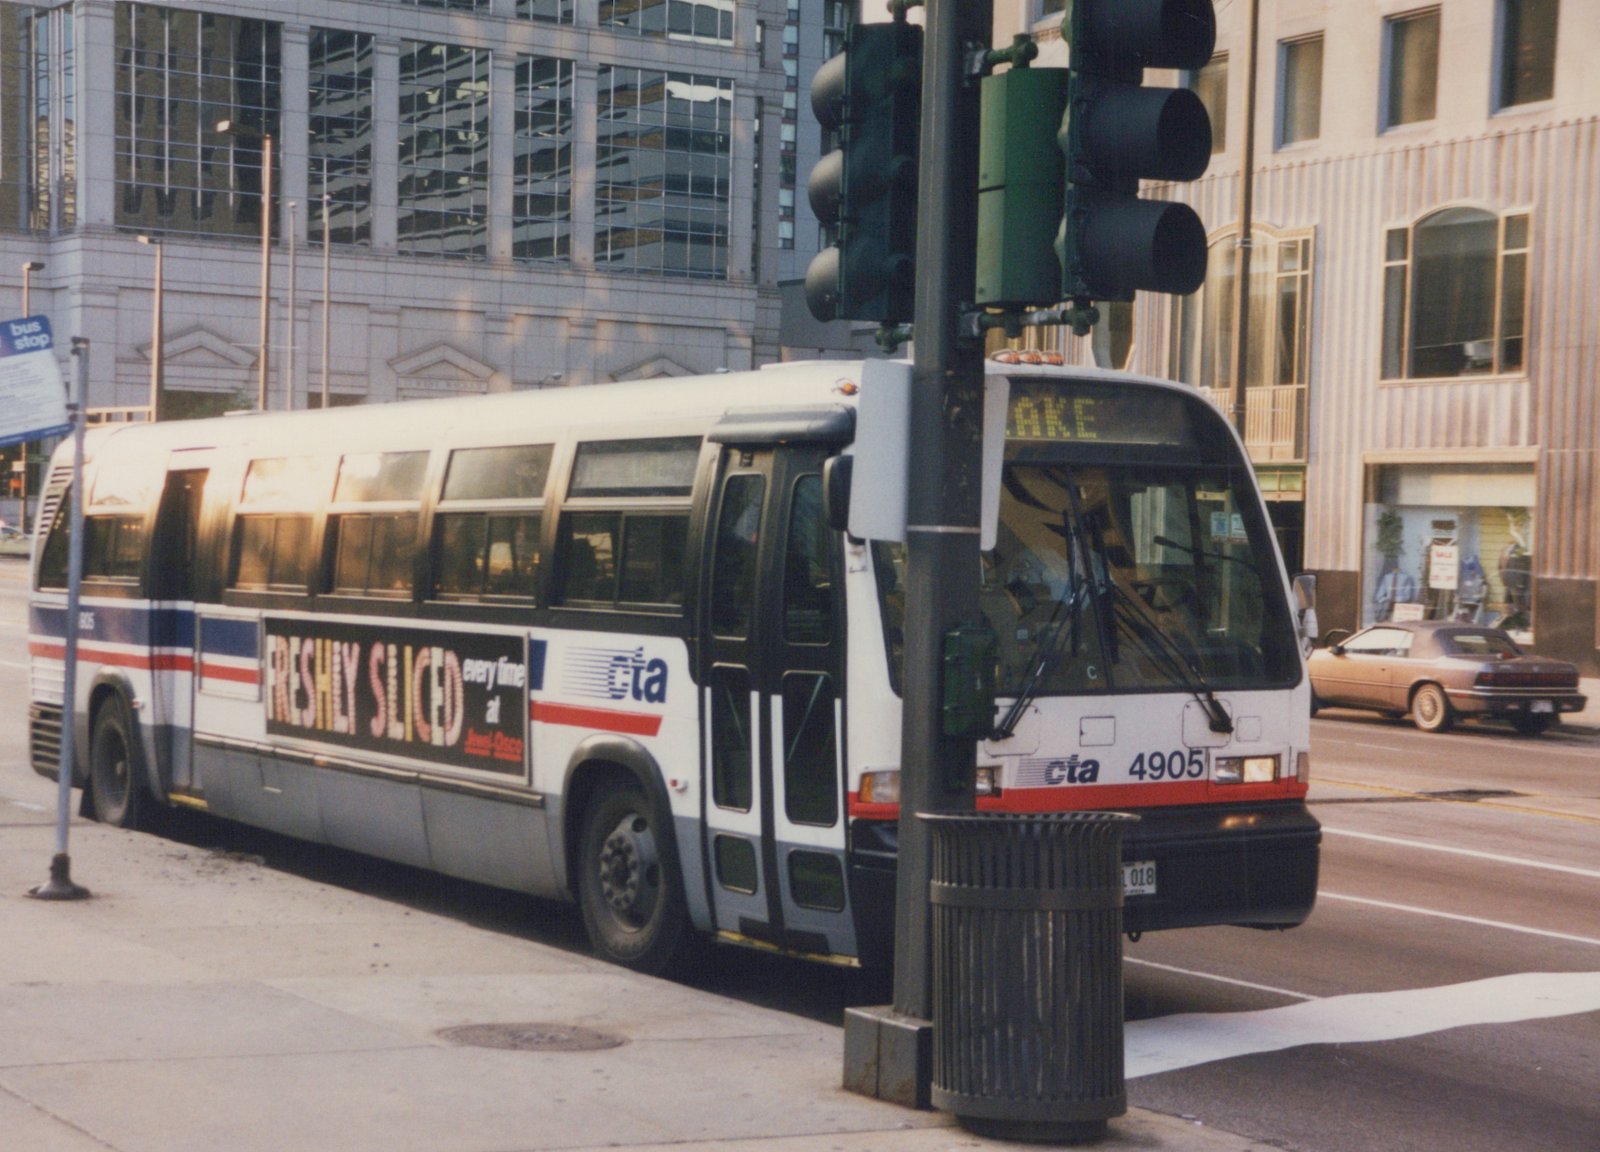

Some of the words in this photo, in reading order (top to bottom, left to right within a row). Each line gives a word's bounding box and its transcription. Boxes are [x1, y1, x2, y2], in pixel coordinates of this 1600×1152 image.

[10, 321, 41, 336] bus
[14, 333, 50, 350] stop
[1005, 396, 1097, 439] AKE
[463, 658, 497, 690] every
[497, 655, 525, 688] time
[608, 646, 668, 703] cta
[267, 635, 360, 735] FRESHLY
[369, 641, 464, 747] SLICED
[486, 695, 500, 724] at
[1044, 754, 1100, 785] cta
[1128, 749, 1204, 781] 4905
[1130, 866, 1154, 887] 018
